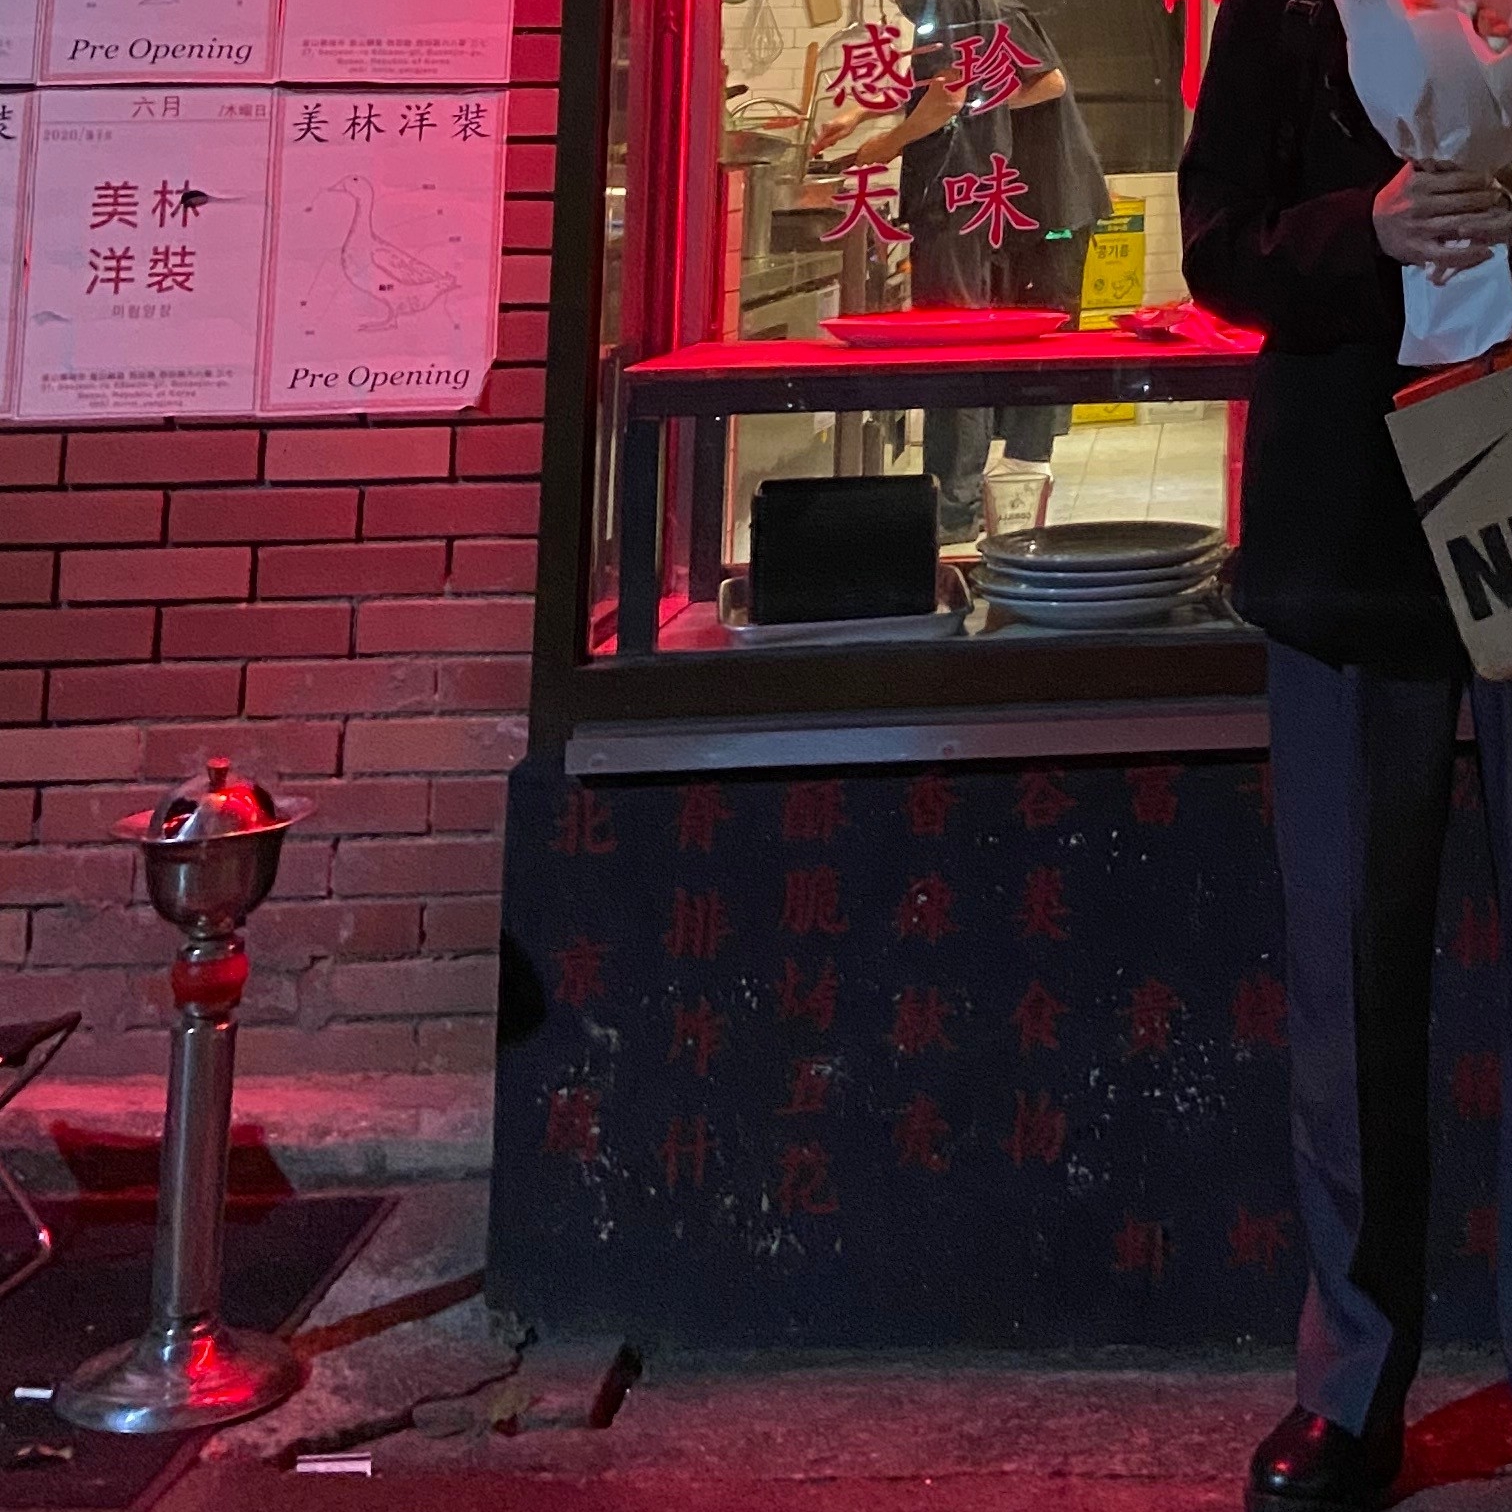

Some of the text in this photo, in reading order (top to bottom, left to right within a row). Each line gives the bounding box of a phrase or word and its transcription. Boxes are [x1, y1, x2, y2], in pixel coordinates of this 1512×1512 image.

[68, 37, 254, 65] Pre Opening
[131, 95, 182, 118] 六月
[287, 365, 471, 394] Pre Opening
